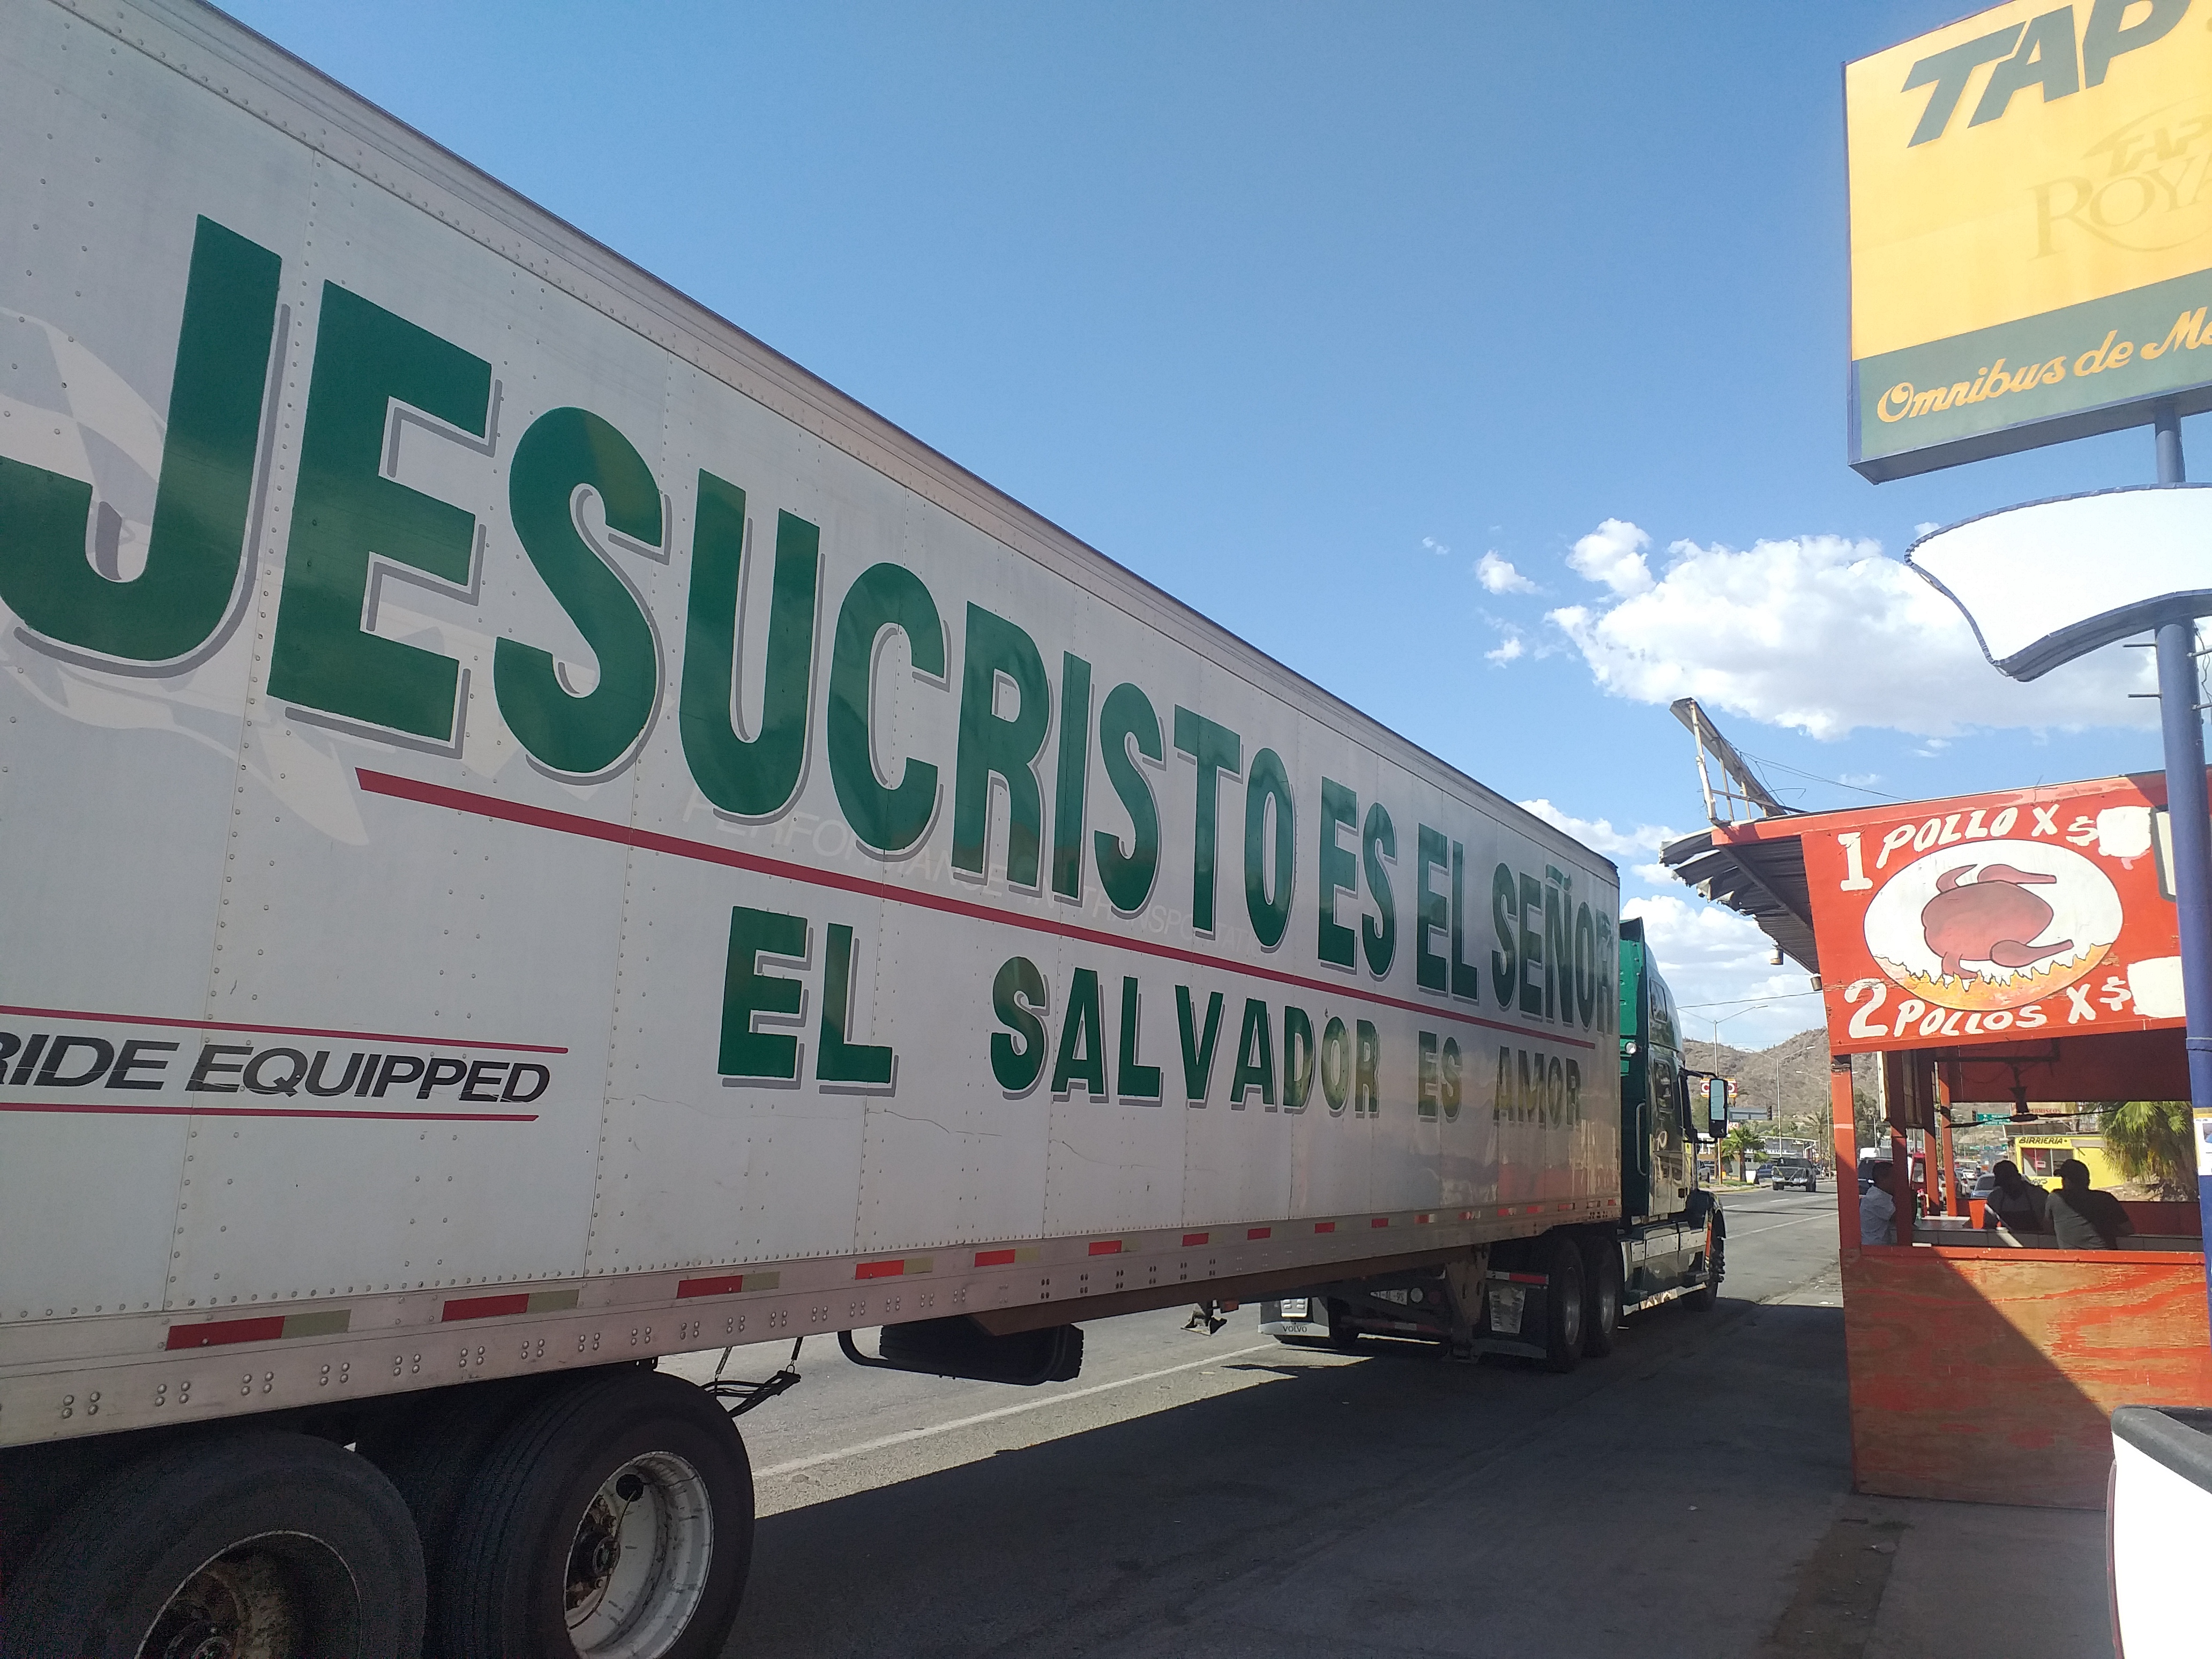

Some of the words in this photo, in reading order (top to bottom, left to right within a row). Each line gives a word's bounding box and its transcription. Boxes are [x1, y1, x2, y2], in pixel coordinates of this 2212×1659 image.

[1901, 0, 2193, 148] TAP
[1877, 356, 2067, 423] Omnibus
[2073, 330, 2134, 377] de
[0, 214, 1291, 953] JESUCRISTO
[1318, 776, 1398, 982] ES
[1416, 823, 1479, 1002] EL
[1491, 863, 1614, 1037] SEÑOR
[1838, 832, 1873, 892] 1
[1876, 808, 2018, 869] POLLO
[718, 906, 899, 1097] EL
[991, 956, 1379, 1118] SALVADOR
[1417, 1030, 1463, 1124] ES
[1493, 1044, 1582, 1130] AMOR
[1844, 978, 1889, 1039] 2
[1893, 999, 2049, 1038] POLLOS
[185, 1044, 551, 1104] EQUIPPED
[2019, 1137, 2063, 1145] BIRRIERIA
[1283, 1325, 1307, 1333] VOLVO
